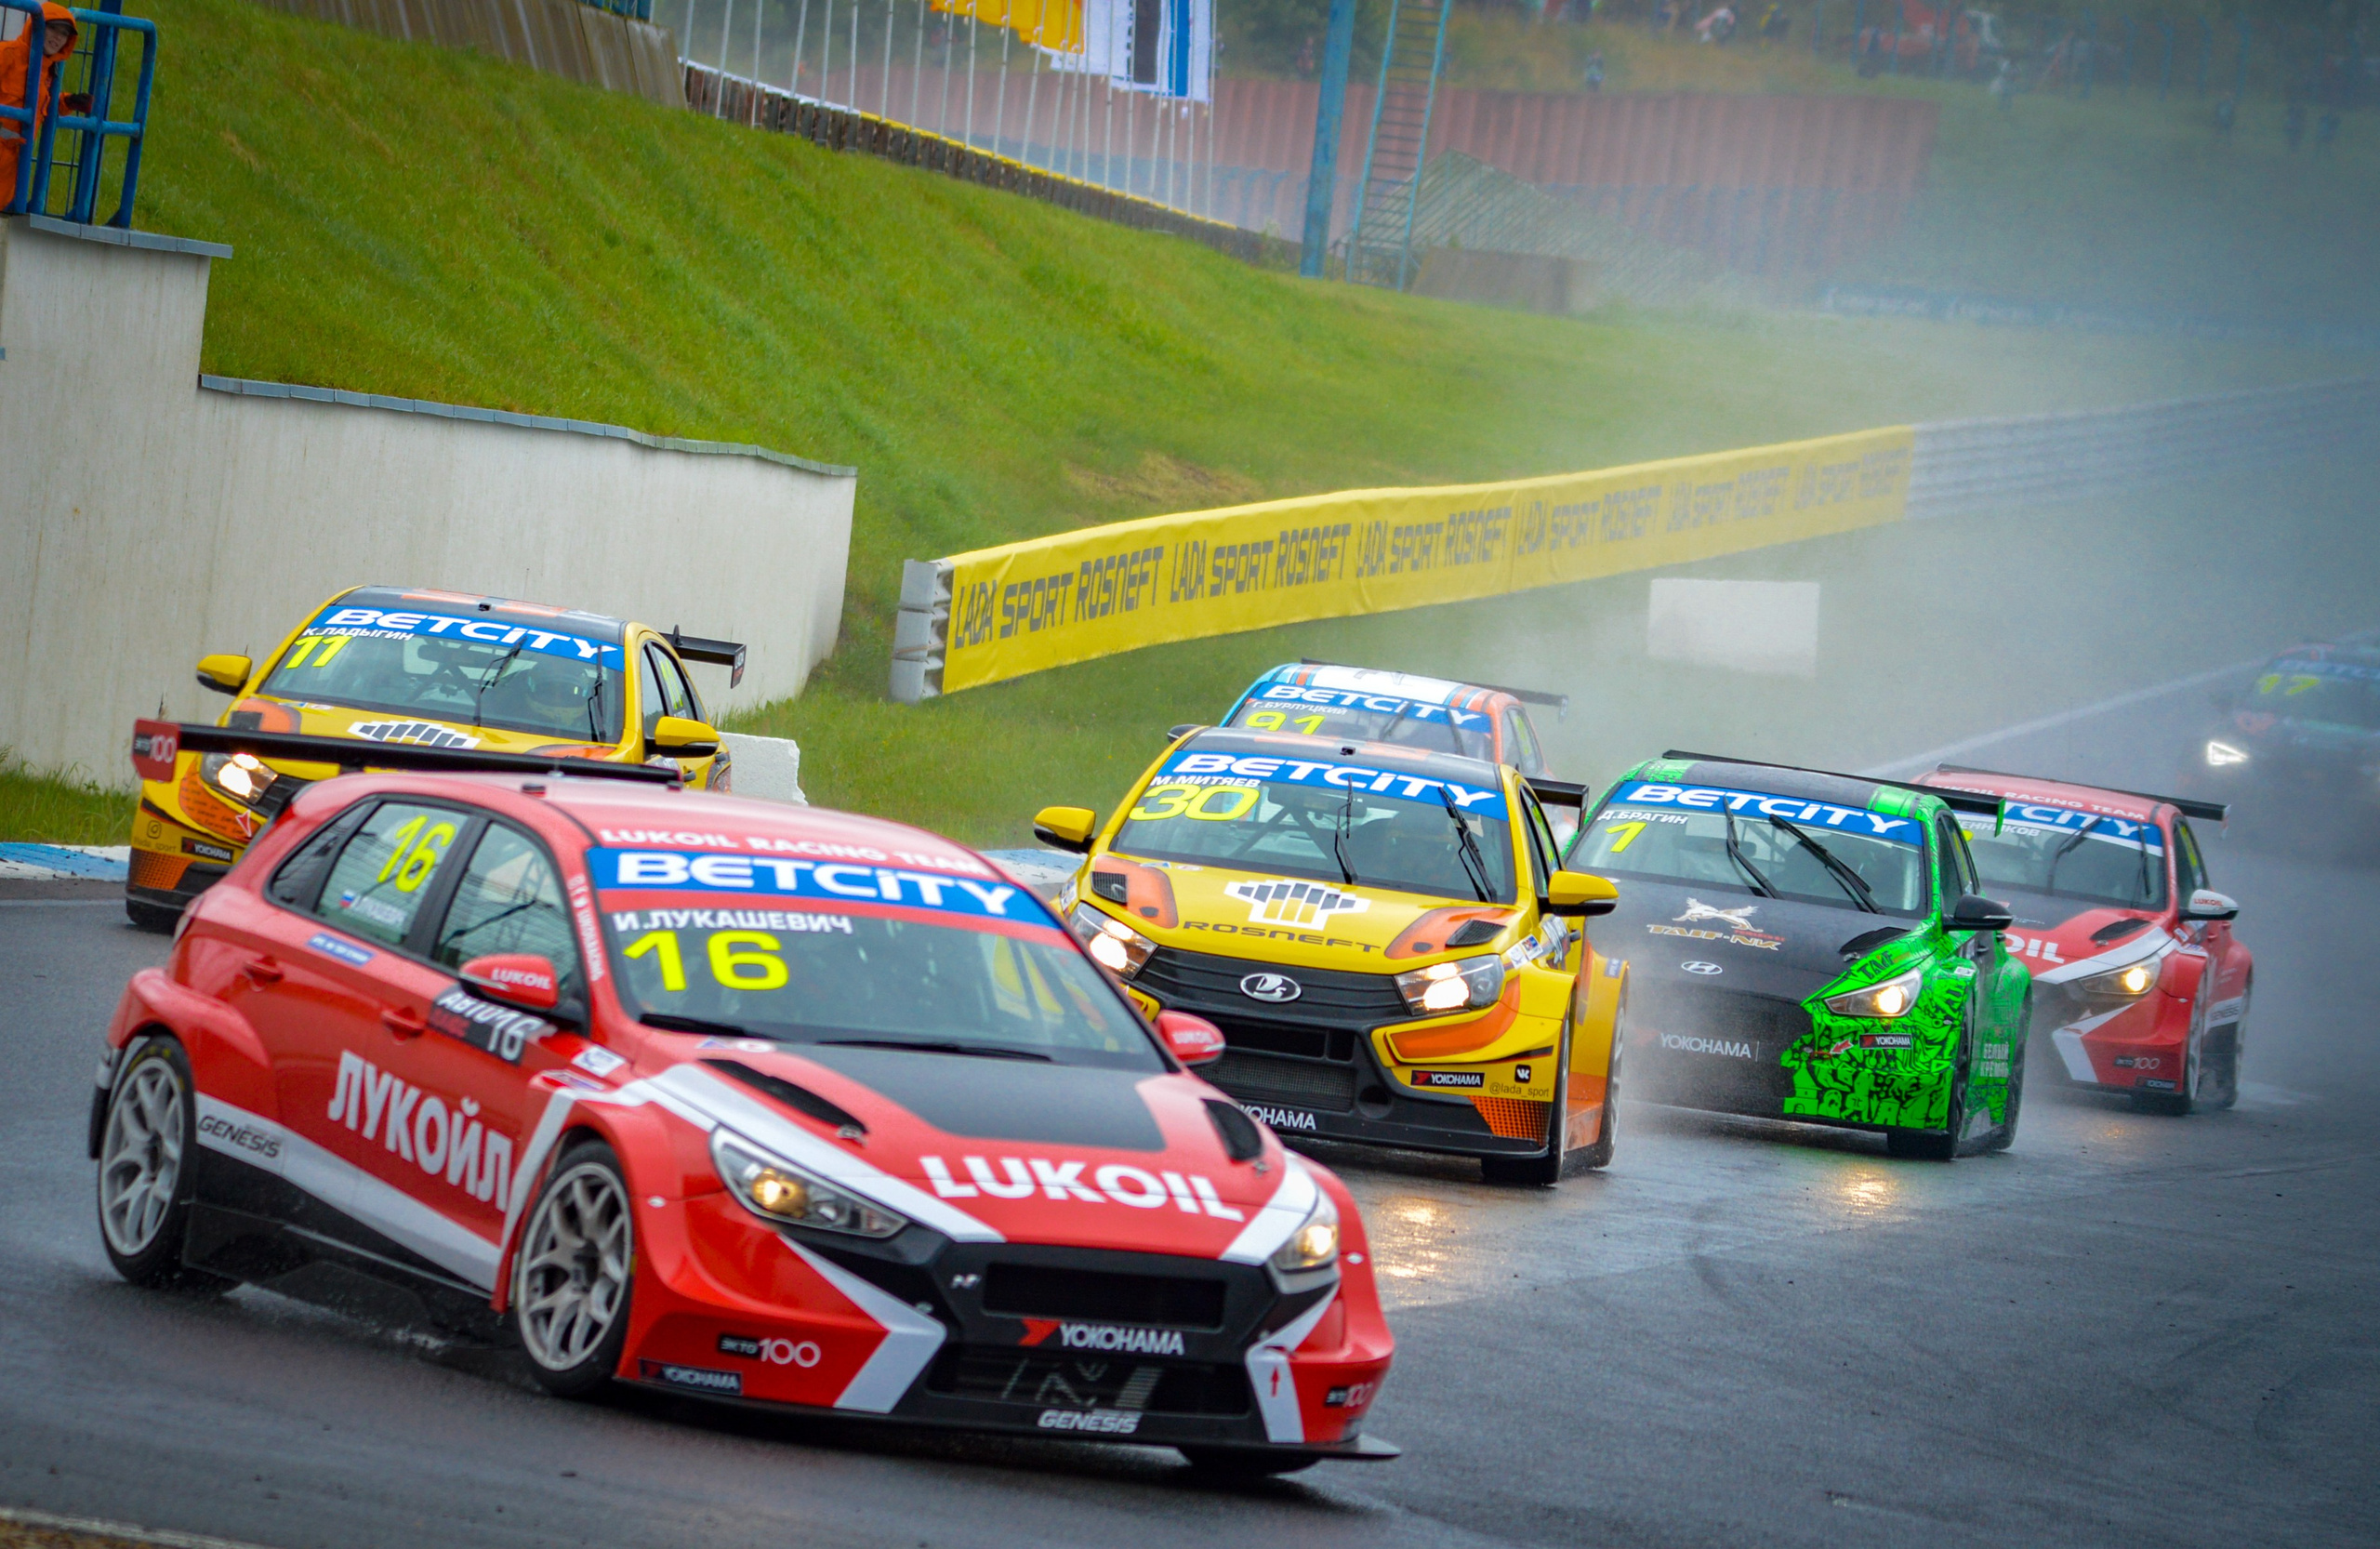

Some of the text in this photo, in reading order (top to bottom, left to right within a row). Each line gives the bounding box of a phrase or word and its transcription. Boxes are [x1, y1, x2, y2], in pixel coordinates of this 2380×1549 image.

[954, 579, 997, 649] LADA
[999, 572, 1074, 639] SPORT
[1074, 546, 1164, 622] ROSNEFT
[1170, 539, 1207, 602] LADA
[1210, 540, 1274, 597] SPORT
[1274, 523, 1352, 589] ROSNEFT
[1356, 521, 1388, 578] LADA
[1390, 522, 1444, 574] SPORT
[1444, 506, 1512, 568] ROSNEFT
[284, 636, 352, 669] 11
[1246, 711, 1326, 735] 91
[1129, 785, 1260, 821] 30
[2004, 791, 2082, 808] RACING
[2091, 804, 2146, 820] TEAM
[600, 828, 990, 876] LUKOIL RACING TEAM
[1606, 821, 1646, 853] 1
[377, 815, 456, 893] 16
[1183, 920, 1382, 953] ROSNEFT
[2003, 933, 2065, 964] OIL
[623, 930, 789, 991] 16
[491, 967, 551, 990] LUKOIL
[1660, 1033, 1752, 1059] YOKOHAMA
[1875, 1036, 1911, 1047] YOKOHAMA
[1431, 1073, 1481, 1085] YOKOHAMA
[1489, 1081, 1550, 1098] @lada_sport
[197, 1115, 281, 1159] GENESIS
[327, 1050, 512, 1211] ЛУКОЙЛ
[919, 1155, 1245, 1223] LUKOIL
[759, 1337, 822, 1368] 100
[1059, 1322, 1185, 1356] YOKOHAMA
[662, 1366, 740, 1390] YOKOHAMA
[1037, 1409, 1143, 1434] GENESIS
